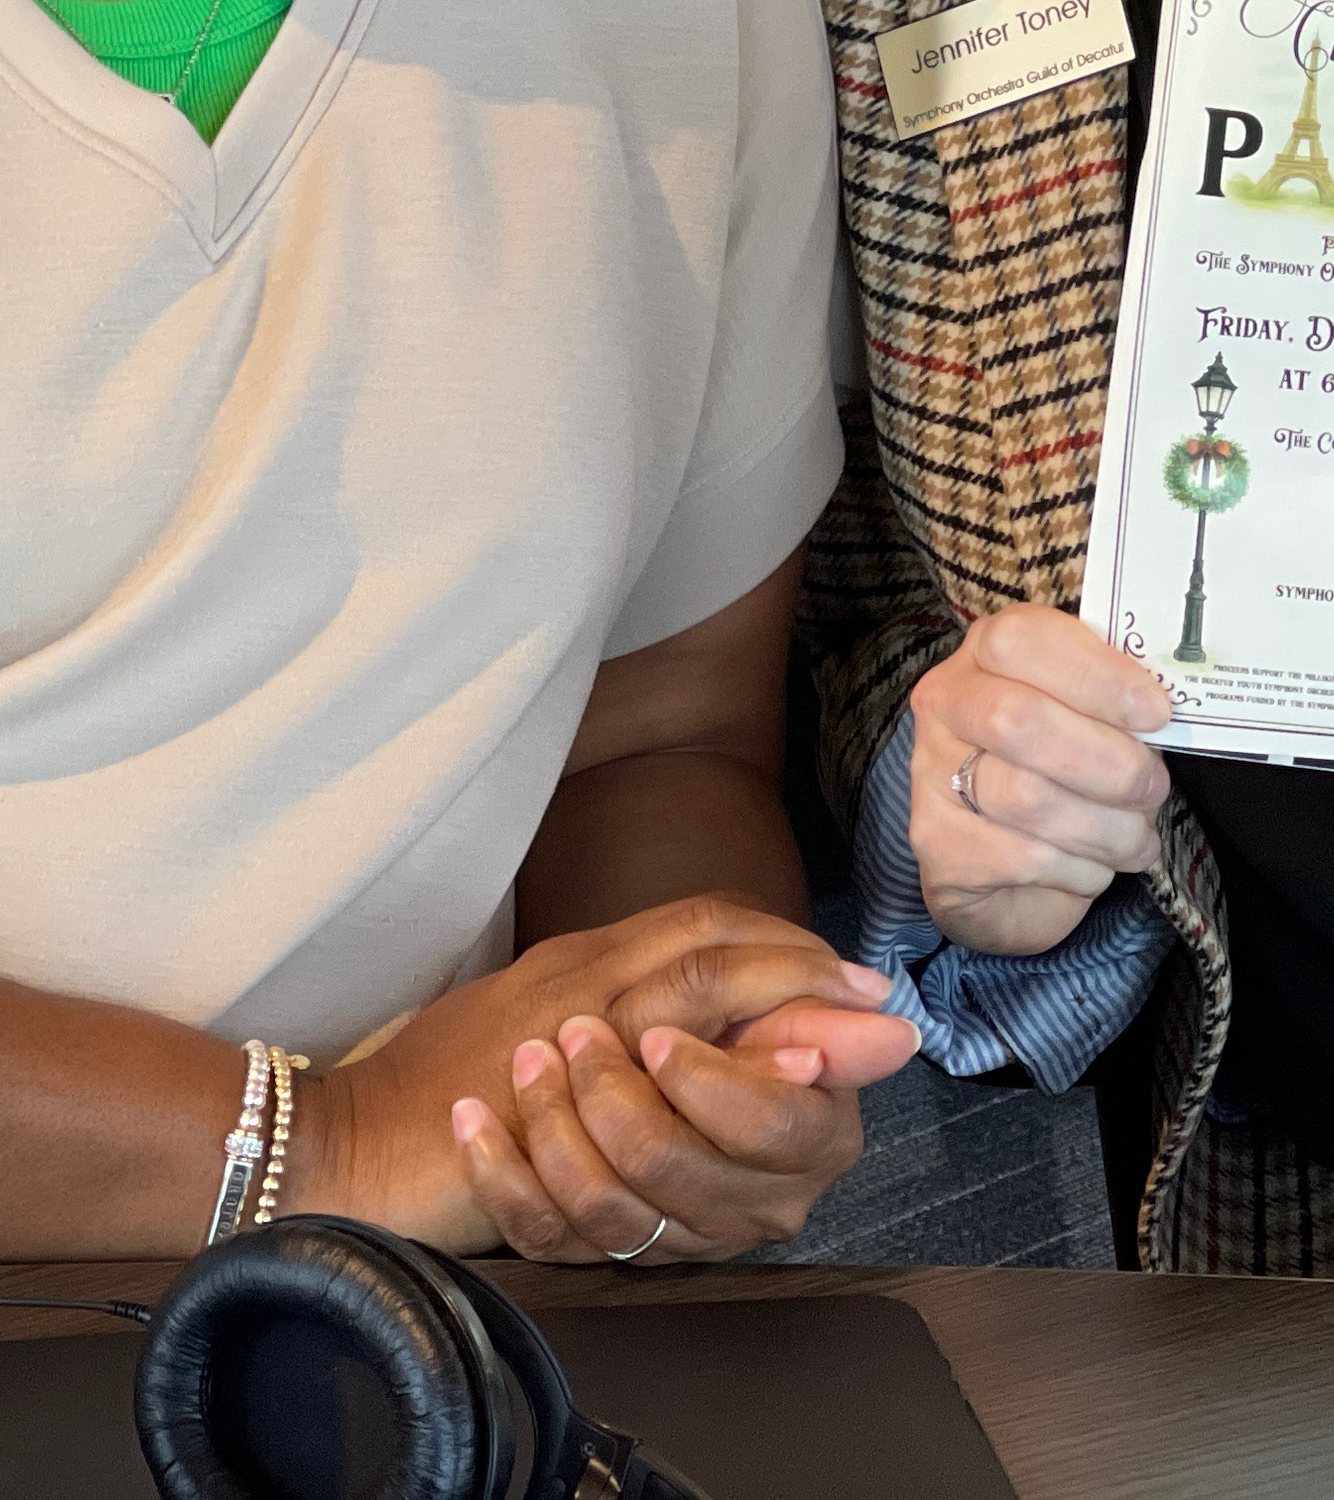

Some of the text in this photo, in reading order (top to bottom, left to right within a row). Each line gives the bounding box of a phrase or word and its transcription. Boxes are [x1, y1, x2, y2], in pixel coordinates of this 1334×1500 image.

[911, 23, 1009, 74] Jennifer
[902, 41, 1125, 129] Symphony Orchestra Guild of Decatur
[1278, 368, 1312, 391] AT
